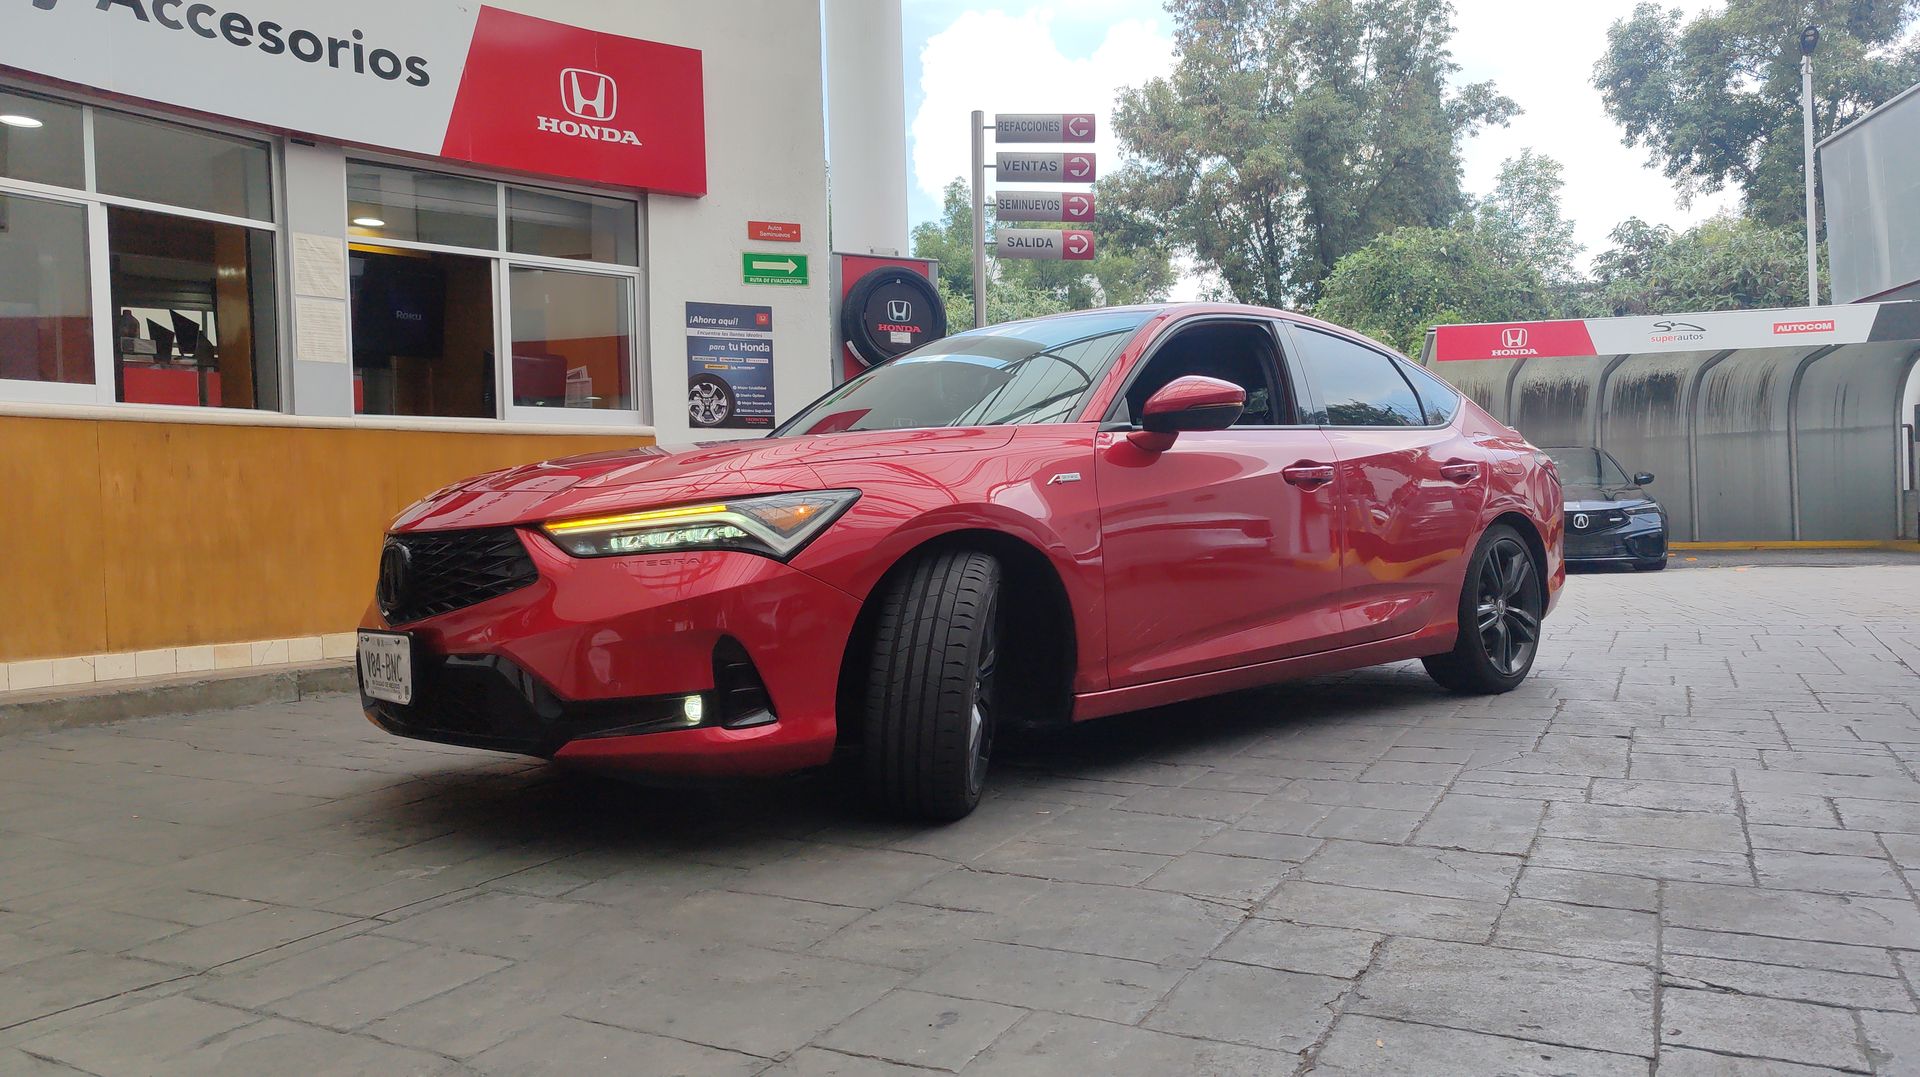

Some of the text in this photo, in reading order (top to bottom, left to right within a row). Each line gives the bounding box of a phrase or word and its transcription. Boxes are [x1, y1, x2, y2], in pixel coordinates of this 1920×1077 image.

[537, 115, 643, 146] HONDA
[998, 121, 1060, 132] REFACCIONES
[1003, 160, 1058, 172] VENTAS
[999, 198, 1060, 211] SEMINUEVOS
[1007, 237, 1054, 248] SALIDA
[689, 315, 739, 326] ¡Ahora aquí!
[877, 323, 922, 333] HONDA
[1776, 322, 1832, 332] AUTOCOM
[1650, 333, 1704, 343] superautos
[728, 343, 739, 351] tu
[740, 342, 770, 352] Honda
[1491, 348, 1539, 356] HONDA
[611, 557, 702, 569] INTEGRA
[365, 651, 402, 682] V84-BNC
